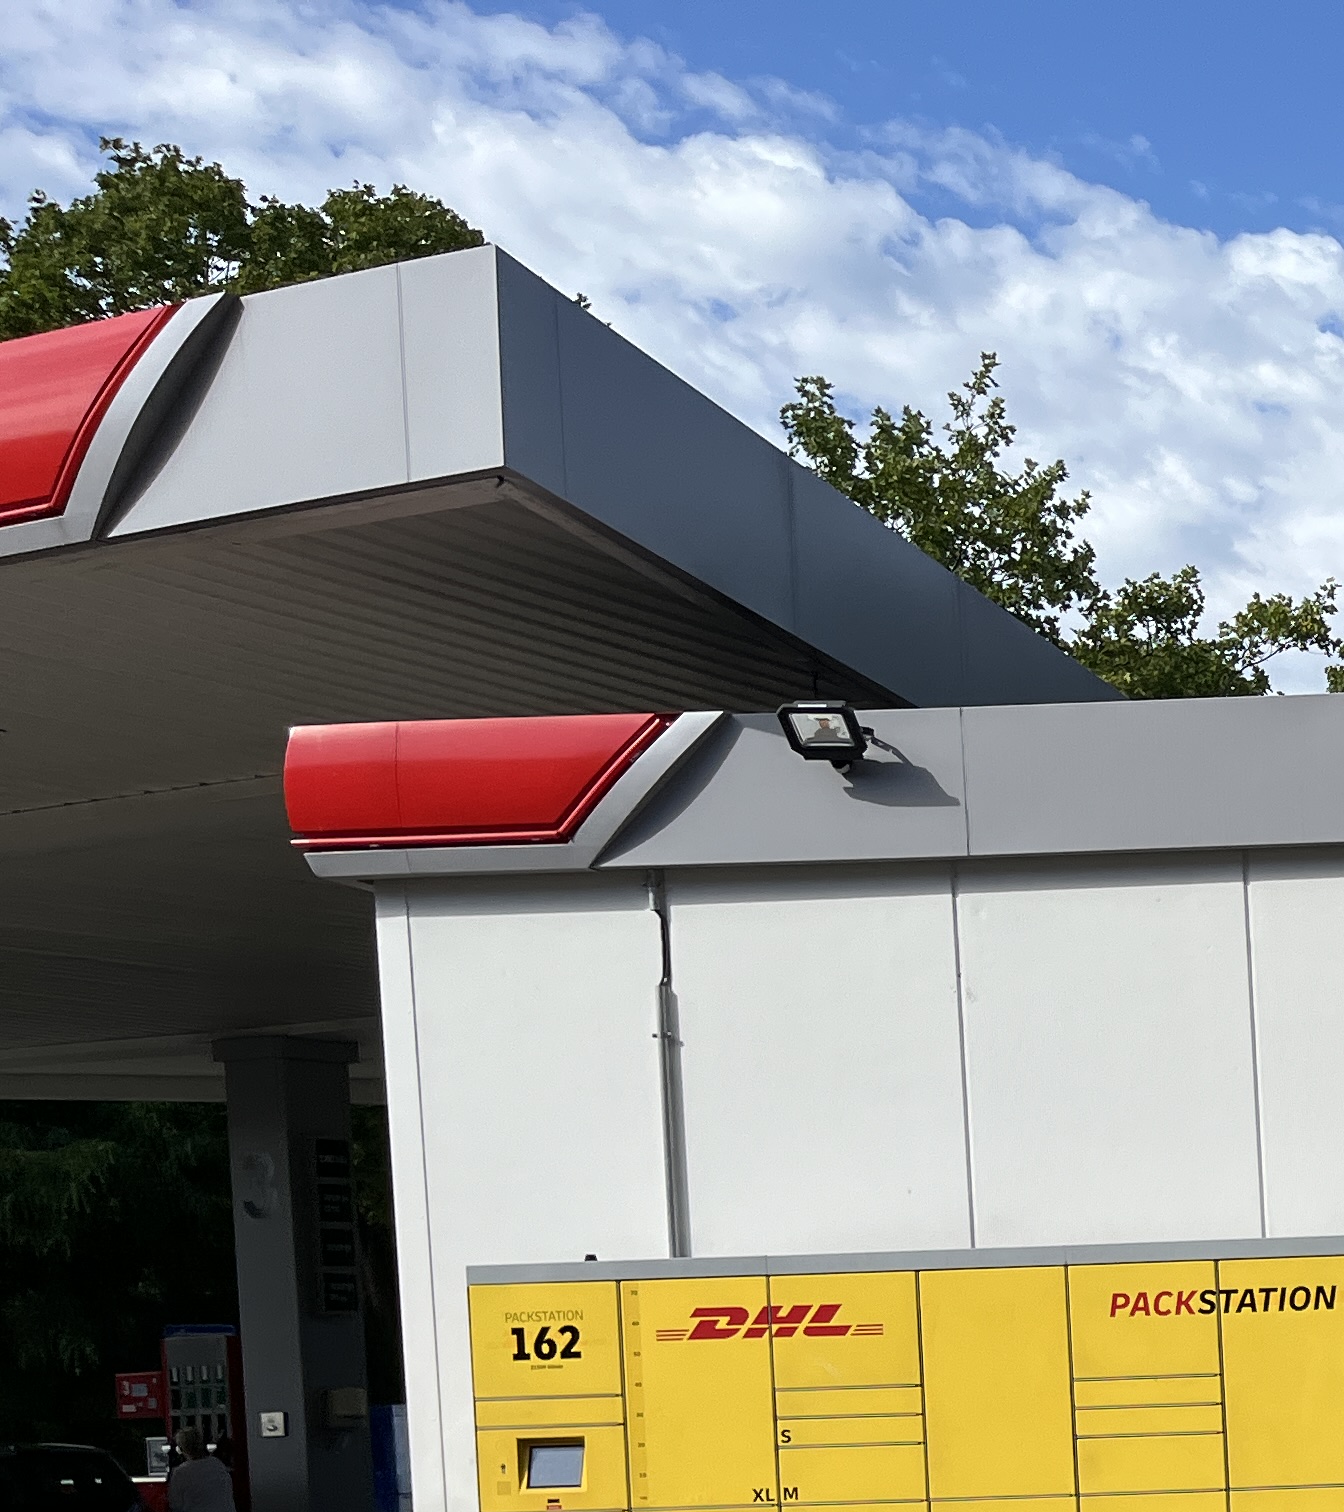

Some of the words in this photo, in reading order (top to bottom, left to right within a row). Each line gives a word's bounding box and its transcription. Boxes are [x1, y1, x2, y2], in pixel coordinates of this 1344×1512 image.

[1109, 1285, 1337, 1318] PACKSTATION
[504, 1309, 584, 1323] PACKSTATION
[687, 1303, 853, 1341] DHL
[511, 1325, 582, 1361] 162
[780, 1429, 792, 1444] S
[752, 1488, 775, 1502] XL
[783, 1487, 799, 1501] M
